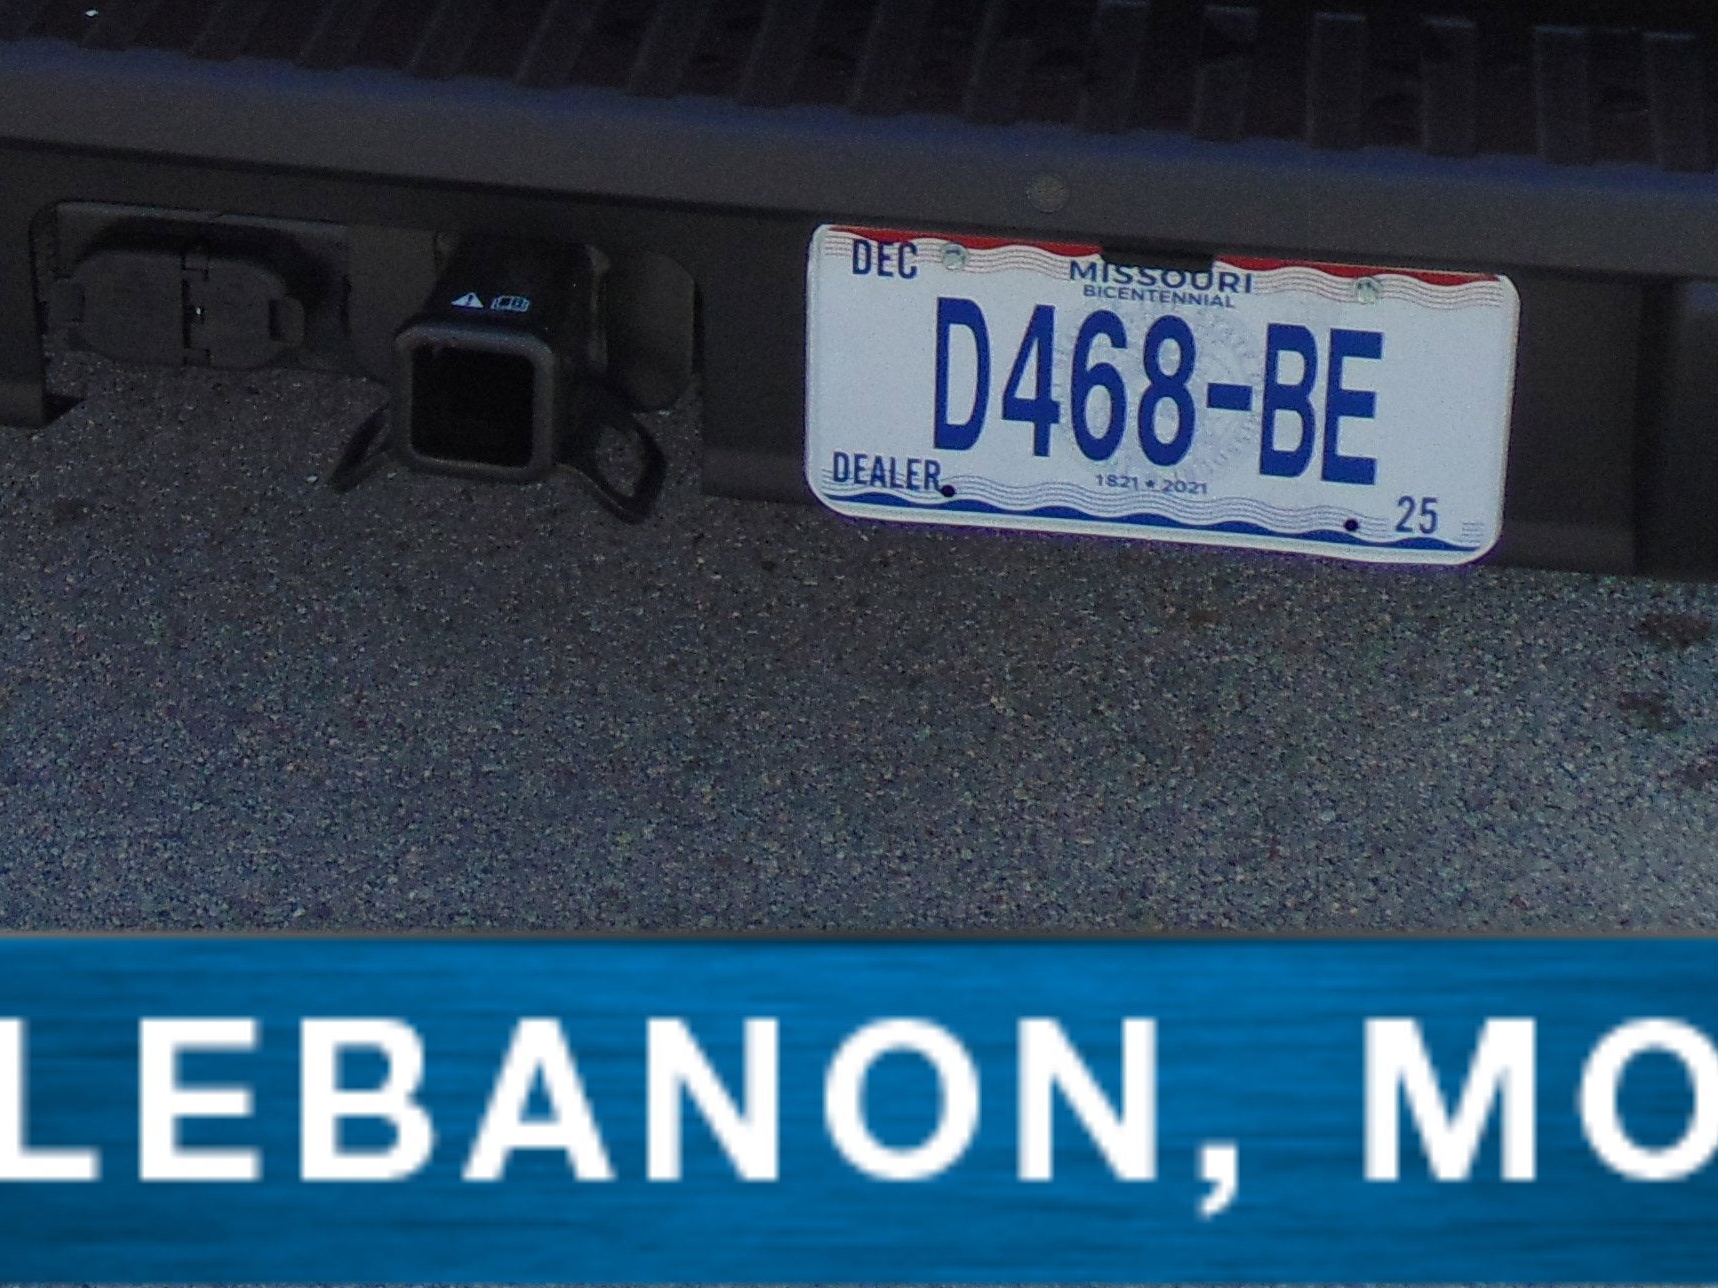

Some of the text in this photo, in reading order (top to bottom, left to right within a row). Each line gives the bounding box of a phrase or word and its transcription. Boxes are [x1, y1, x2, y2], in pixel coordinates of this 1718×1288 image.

[851, 238, 919, 281] DEC
[1069, 258, 1254, 295] MISSOURI
[1082, 283, 1237, 310] BICENTENNIAL
[932, 295, 1385, 486] D468-BE
[831, 451, 943, 492] DEALER
[1095, 473, 1208, 495] 1821 2021
[1395, 495, 1439, 535] 25
